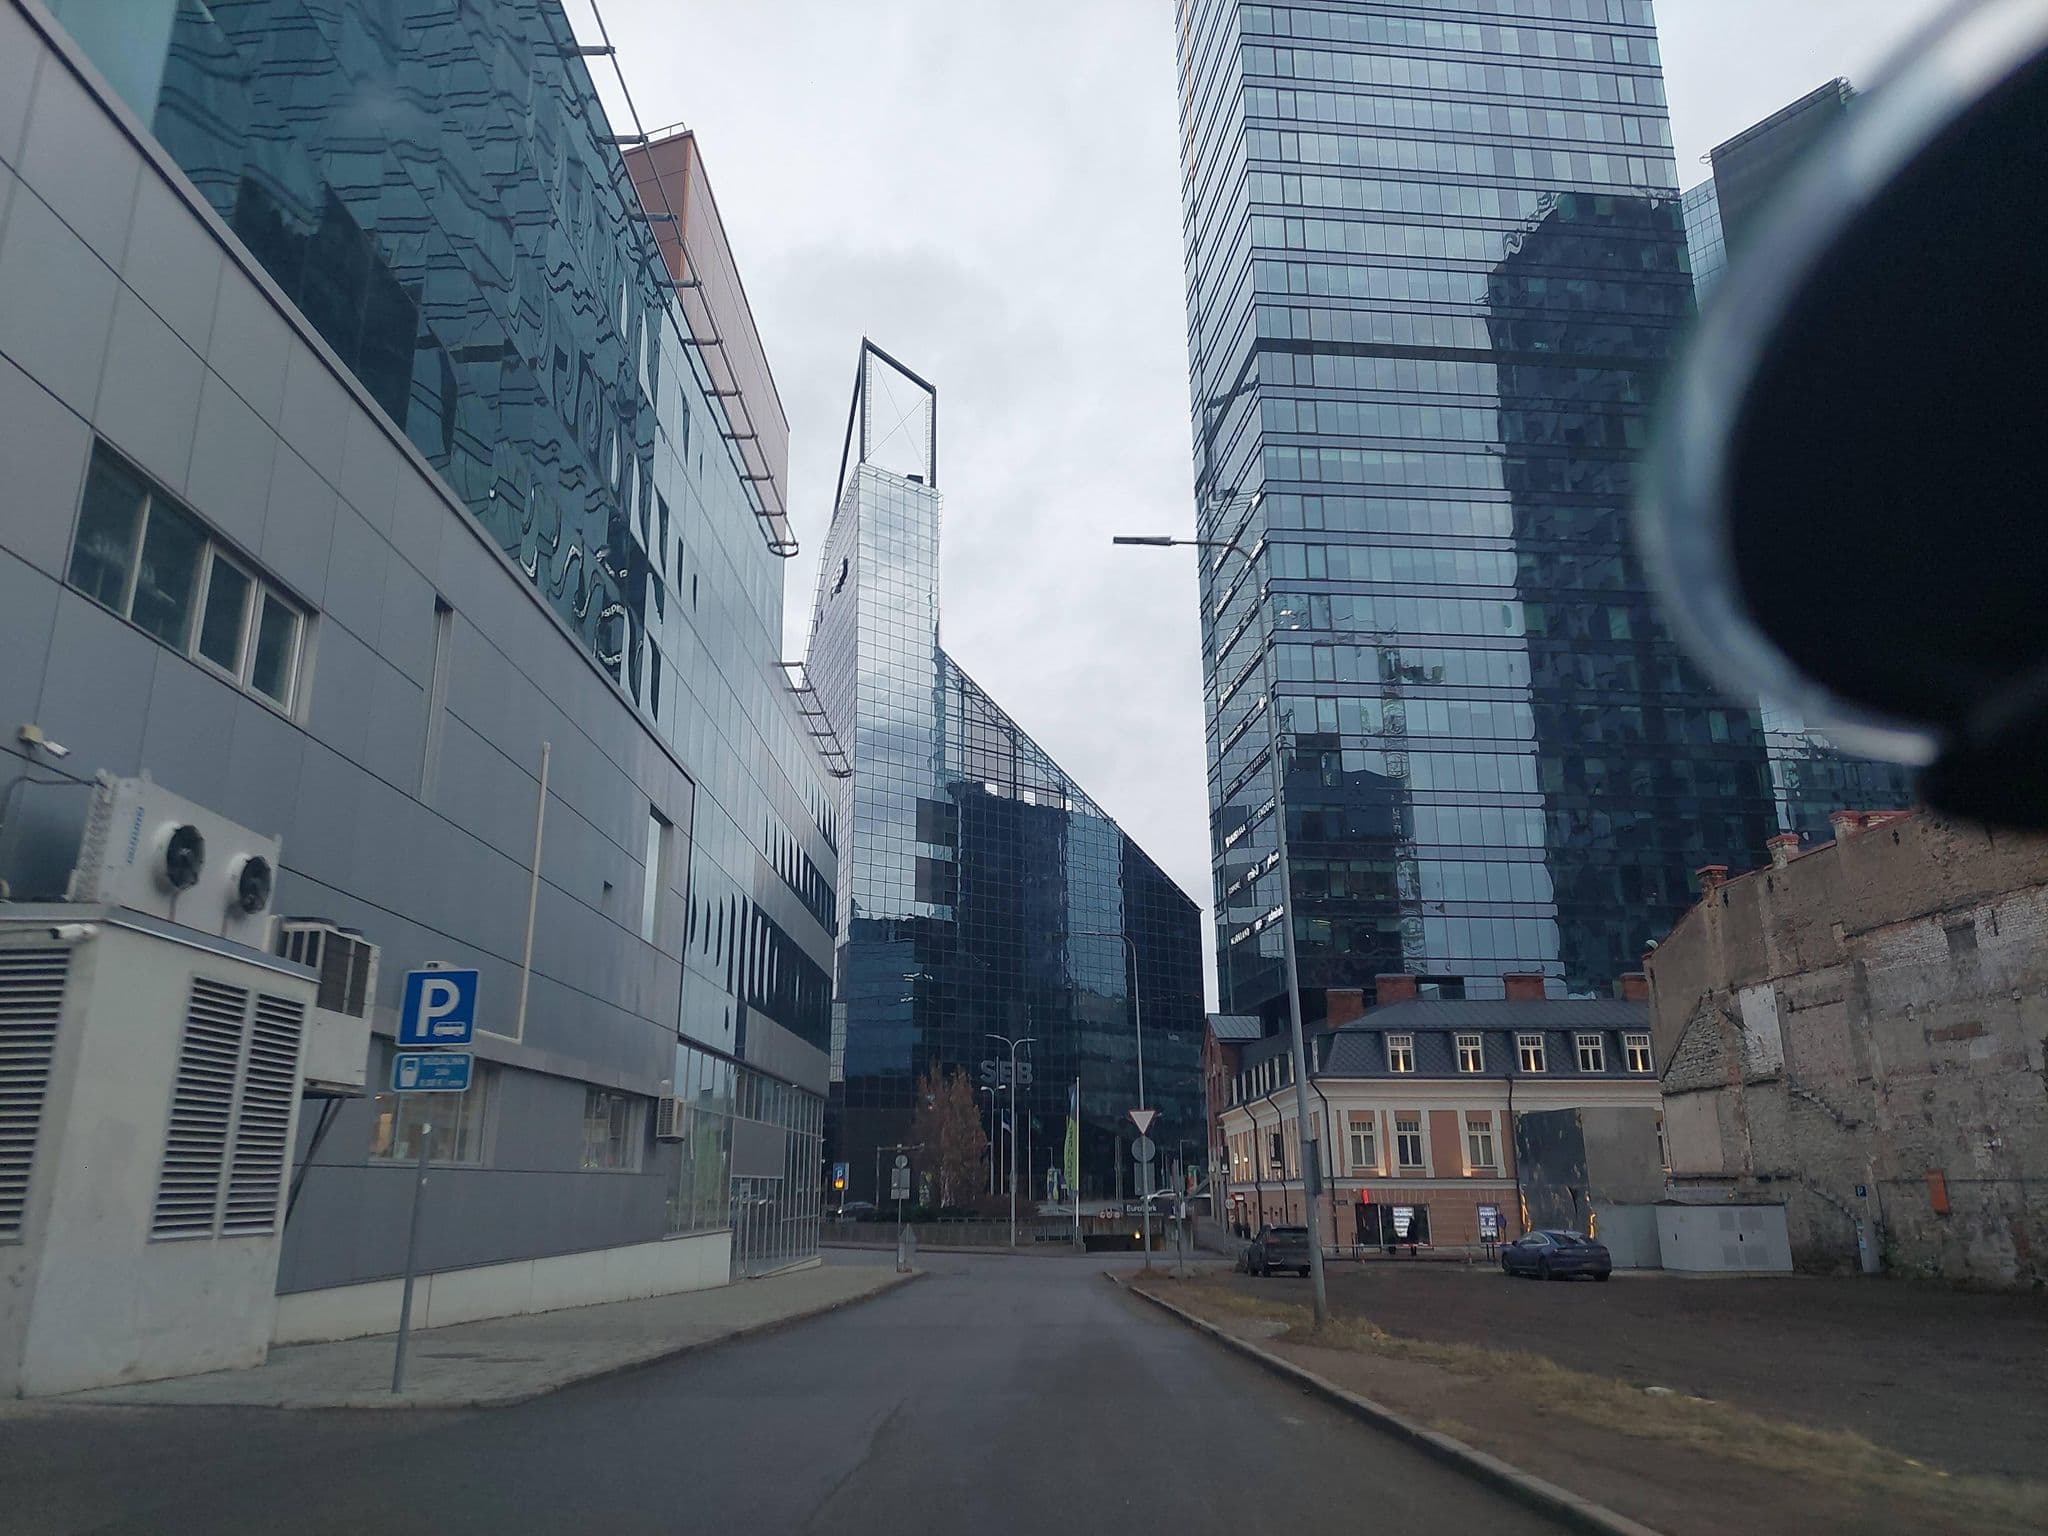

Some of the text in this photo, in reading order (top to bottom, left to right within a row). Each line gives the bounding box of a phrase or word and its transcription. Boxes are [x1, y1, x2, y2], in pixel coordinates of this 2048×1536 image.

[415, 978, 460, 1037] P
[980, 1060, 1033, 1084] SEB
[1126, 1204, 1157, 1212] Eurork
